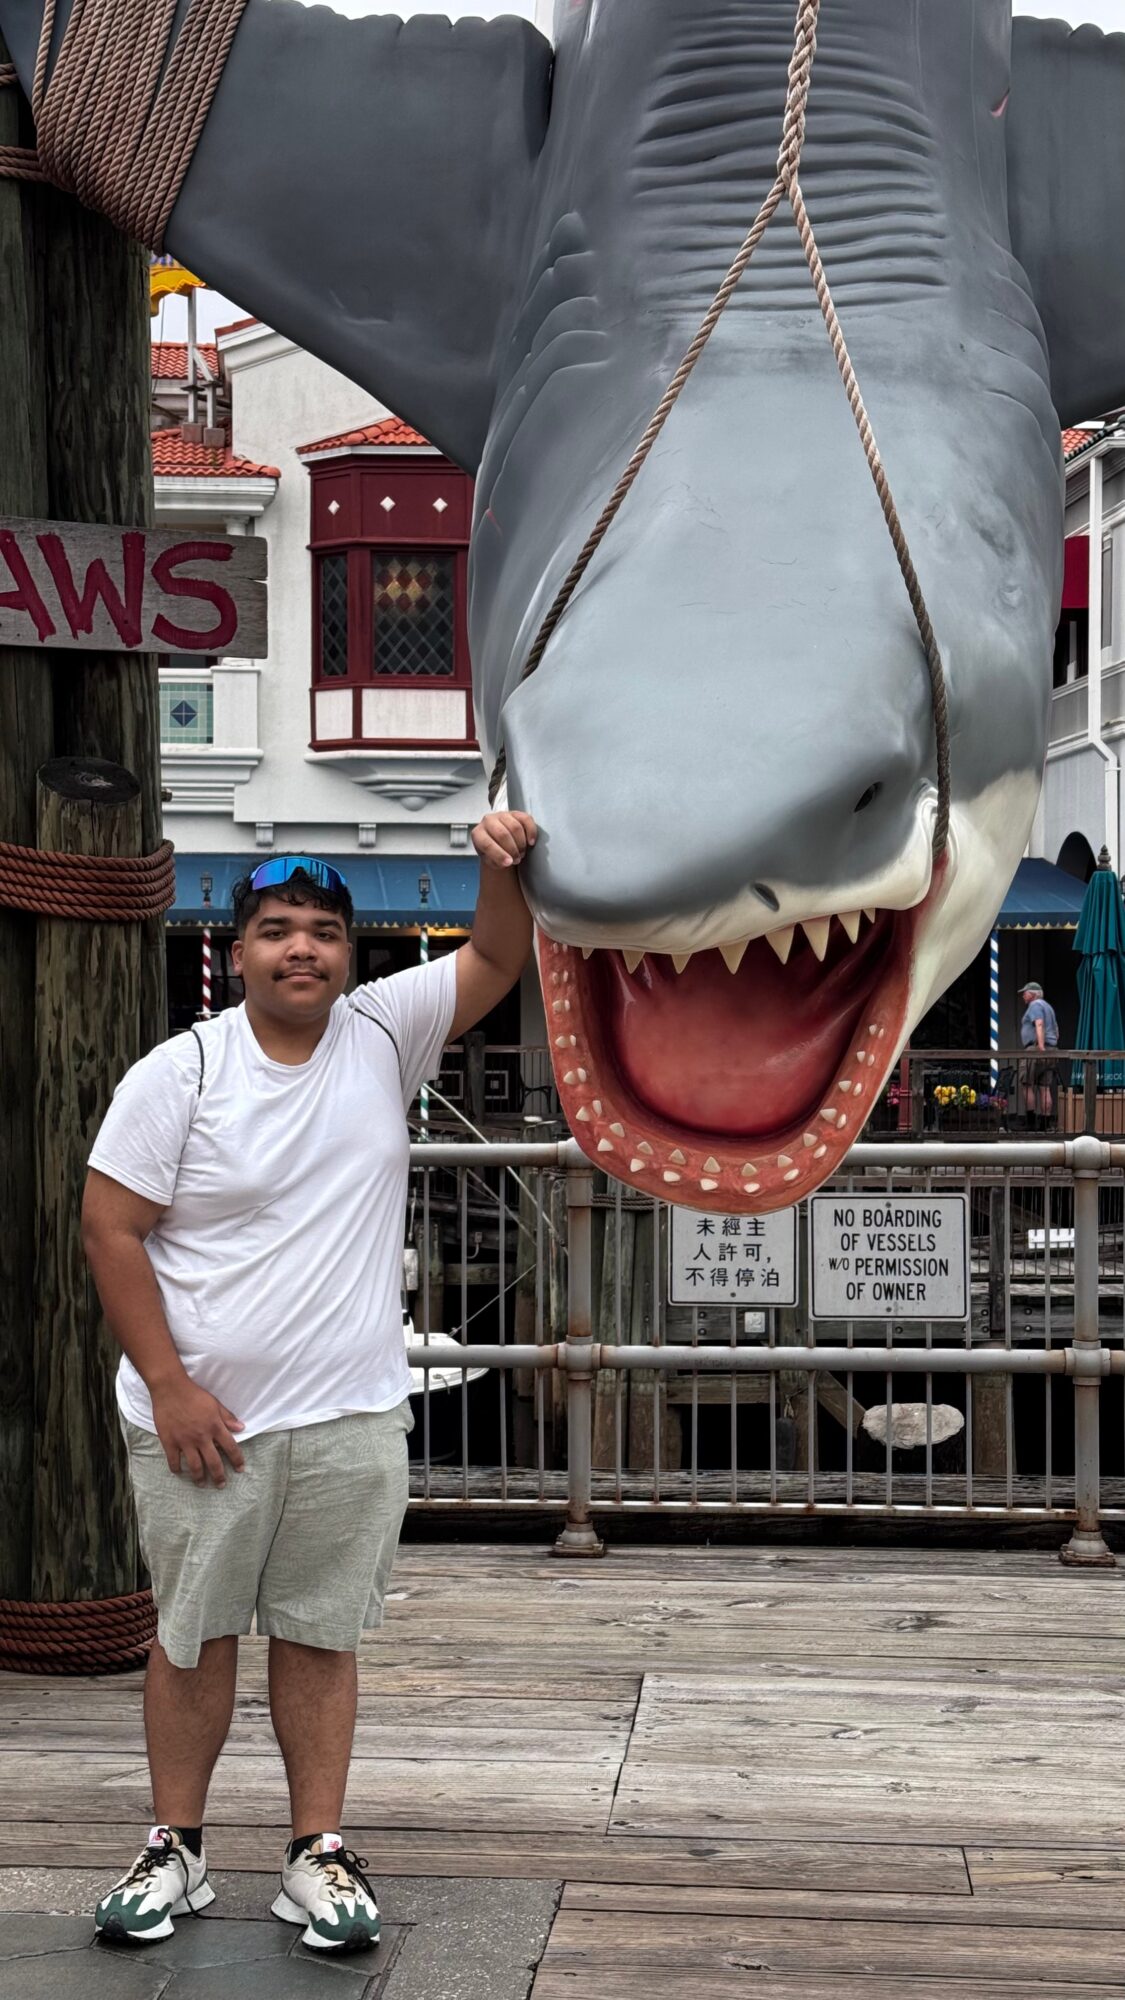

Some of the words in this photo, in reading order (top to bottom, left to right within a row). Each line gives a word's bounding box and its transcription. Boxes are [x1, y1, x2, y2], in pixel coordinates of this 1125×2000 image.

[696, 1217, 766, 1236] 未經主
[833, 1208, 855, 1227] NO
[862, 1208, 942, 1228] BOARDING
[840, 1232, 860, 1251] OF
[866, 1233, 936, 1252] VESSELS
[828, 1257, 850, 1271] W/O
[855, 1258, 949, 1277] PERMISSION
[685, 1267, 780, 1288] 不得停泊
[846, 1281, 866, 1301] OF
[872, 1282, 926, 1301] OWNER
